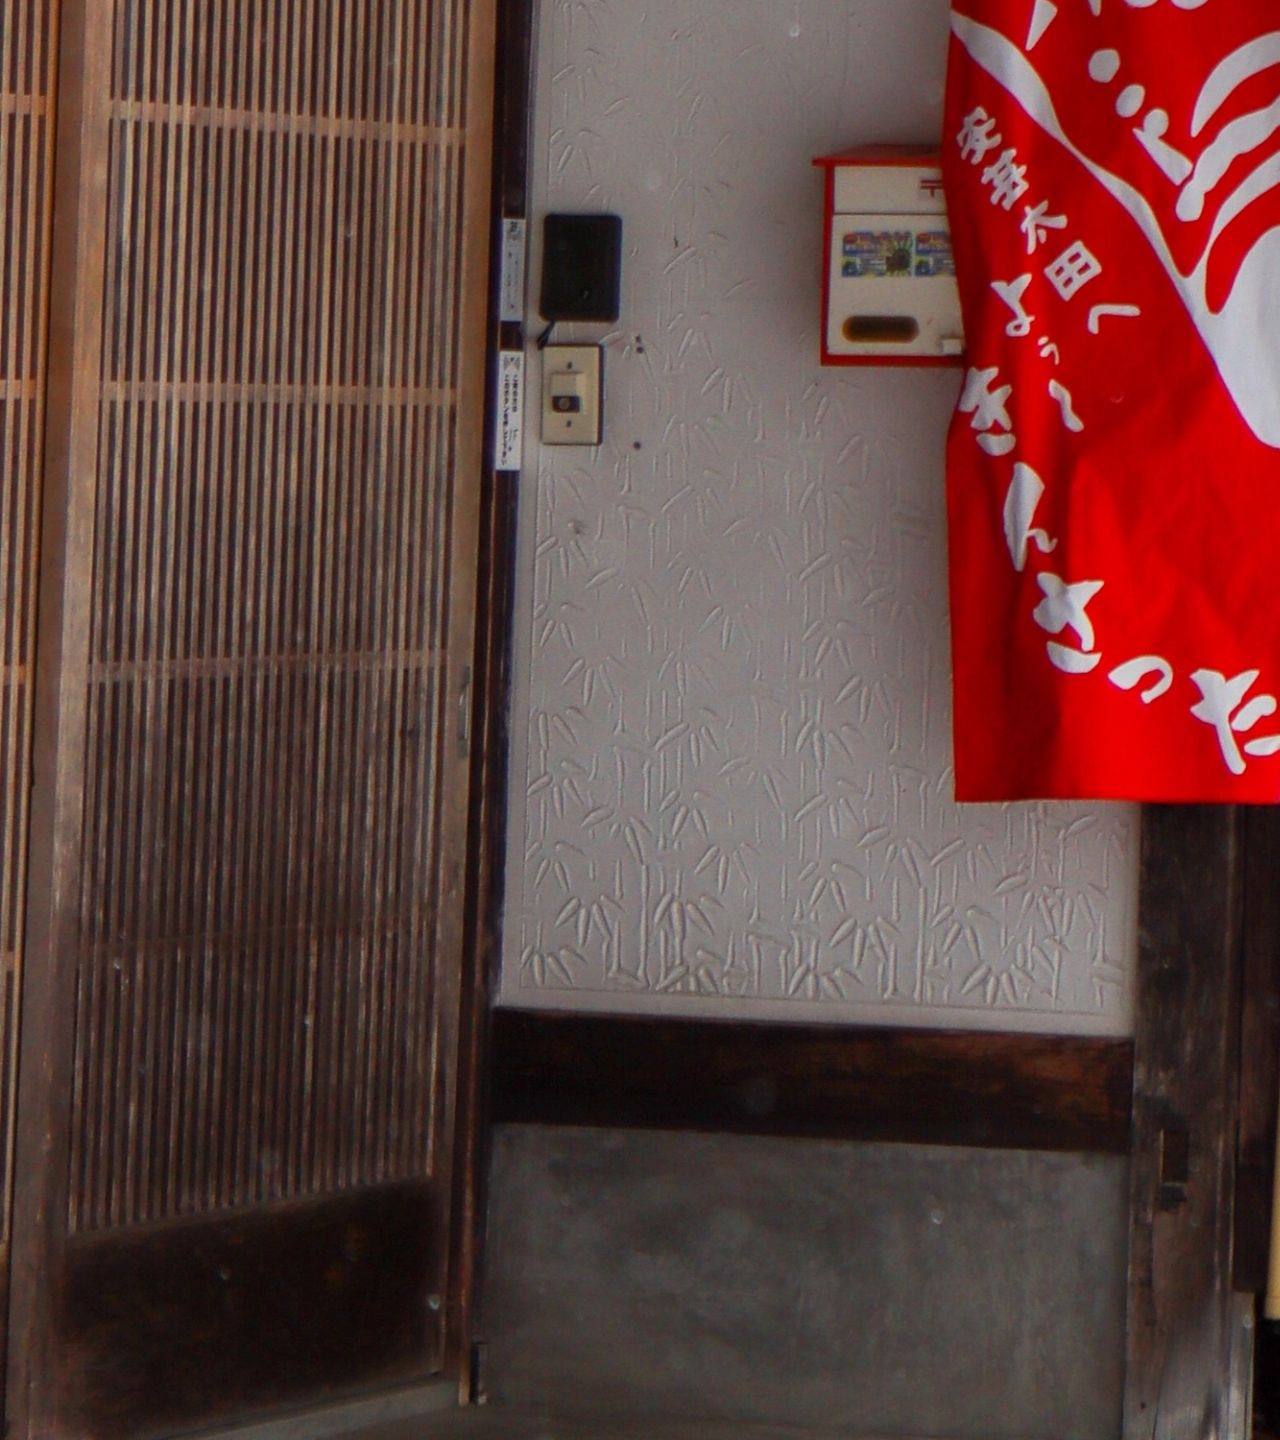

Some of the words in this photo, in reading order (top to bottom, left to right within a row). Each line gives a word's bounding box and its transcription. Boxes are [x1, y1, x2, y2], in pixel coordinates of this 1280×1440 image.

[957, 107, 1141, 334] 安芸太田へ
